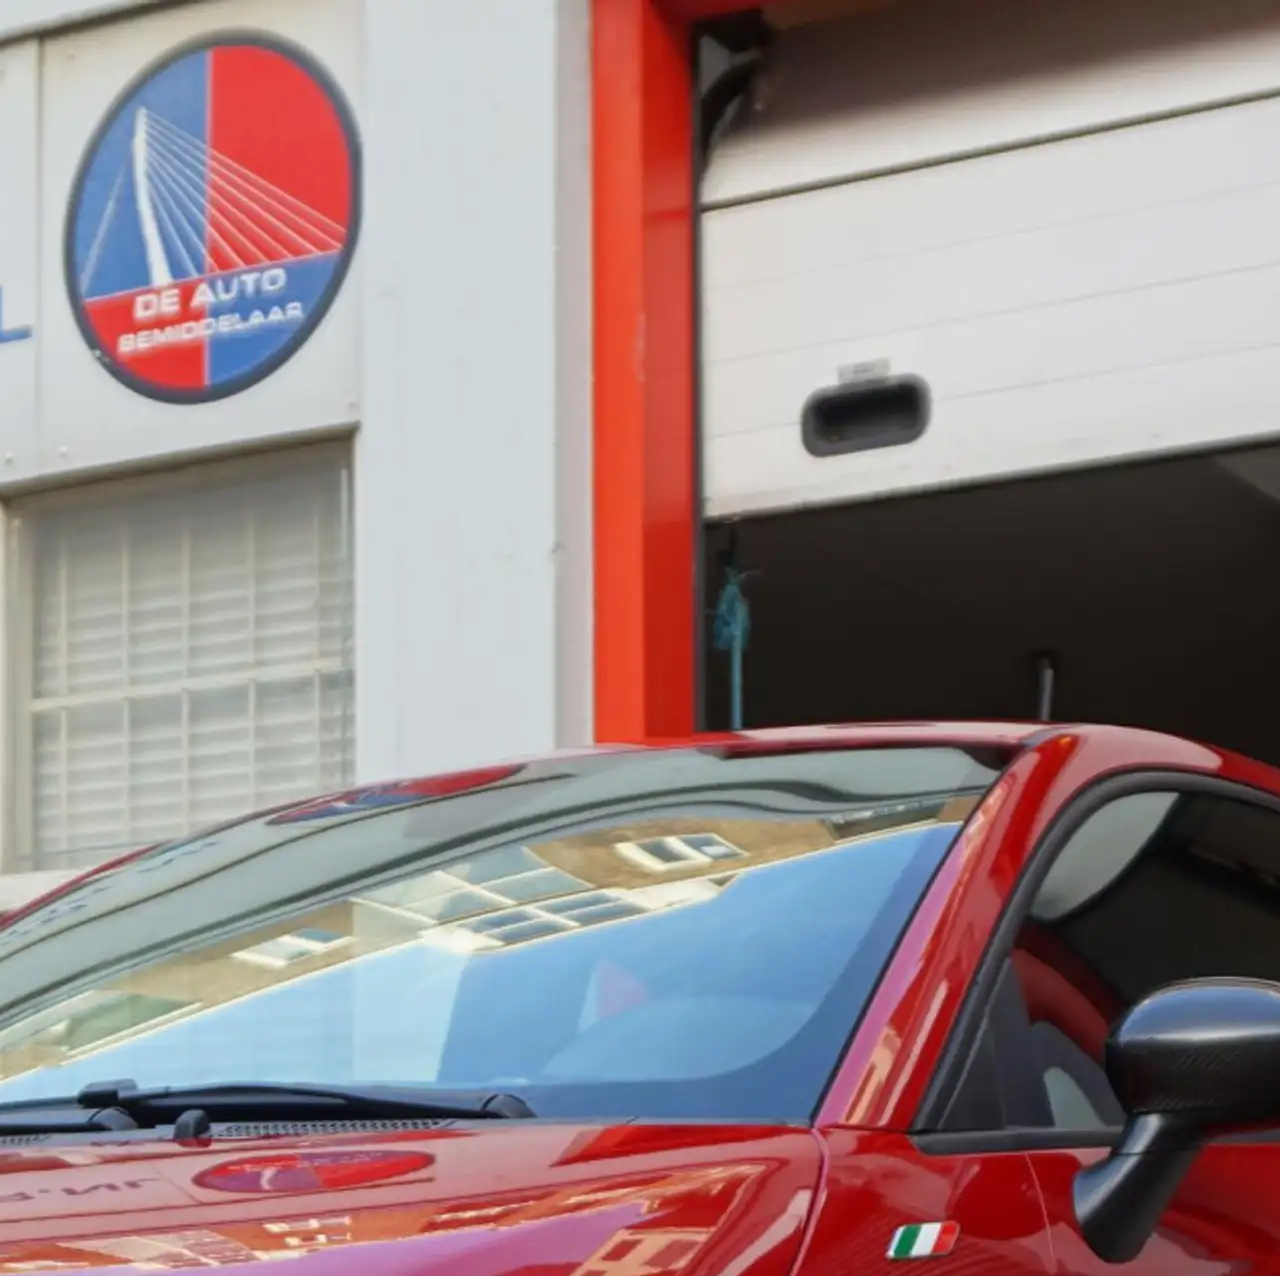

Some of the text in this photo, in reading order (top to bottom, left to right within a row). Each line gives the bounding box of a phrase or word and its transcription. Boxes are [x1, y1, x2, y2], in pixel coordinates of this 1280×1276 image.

[132, 267, 287, 319] DE AUTO
[117, 301, 302, 353] BEMIDDELAAR
